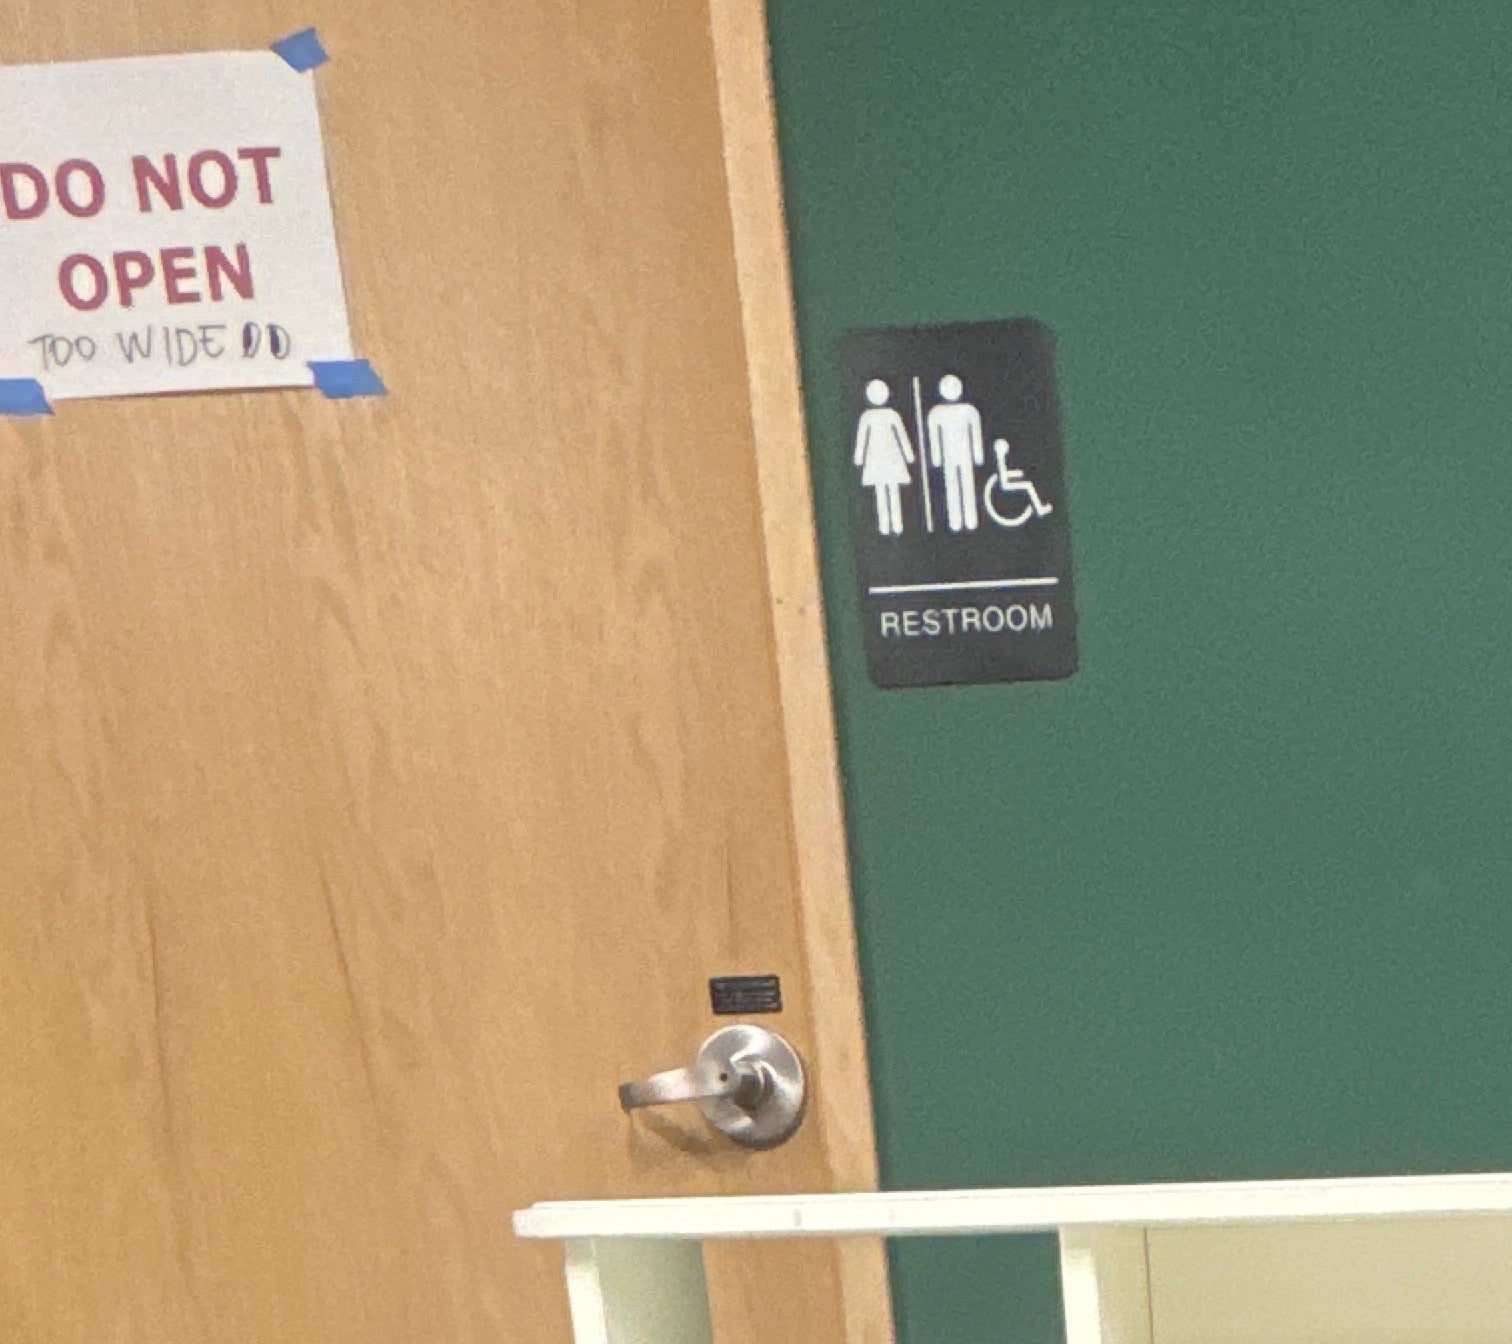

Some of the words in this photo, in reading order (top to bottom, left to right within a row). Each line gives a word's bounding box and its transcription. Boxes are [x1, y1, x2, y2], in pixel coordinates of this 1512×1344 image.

[0, 157, 105, 220] DO
[132, 147, 281, 213] NOT
[58, 243, 255, 312] OPEN
[28, 333, 96, 372] TOO
[116, 323, 227, 367] WIDE
[880, 603, 1053, 638] RESTROOM
